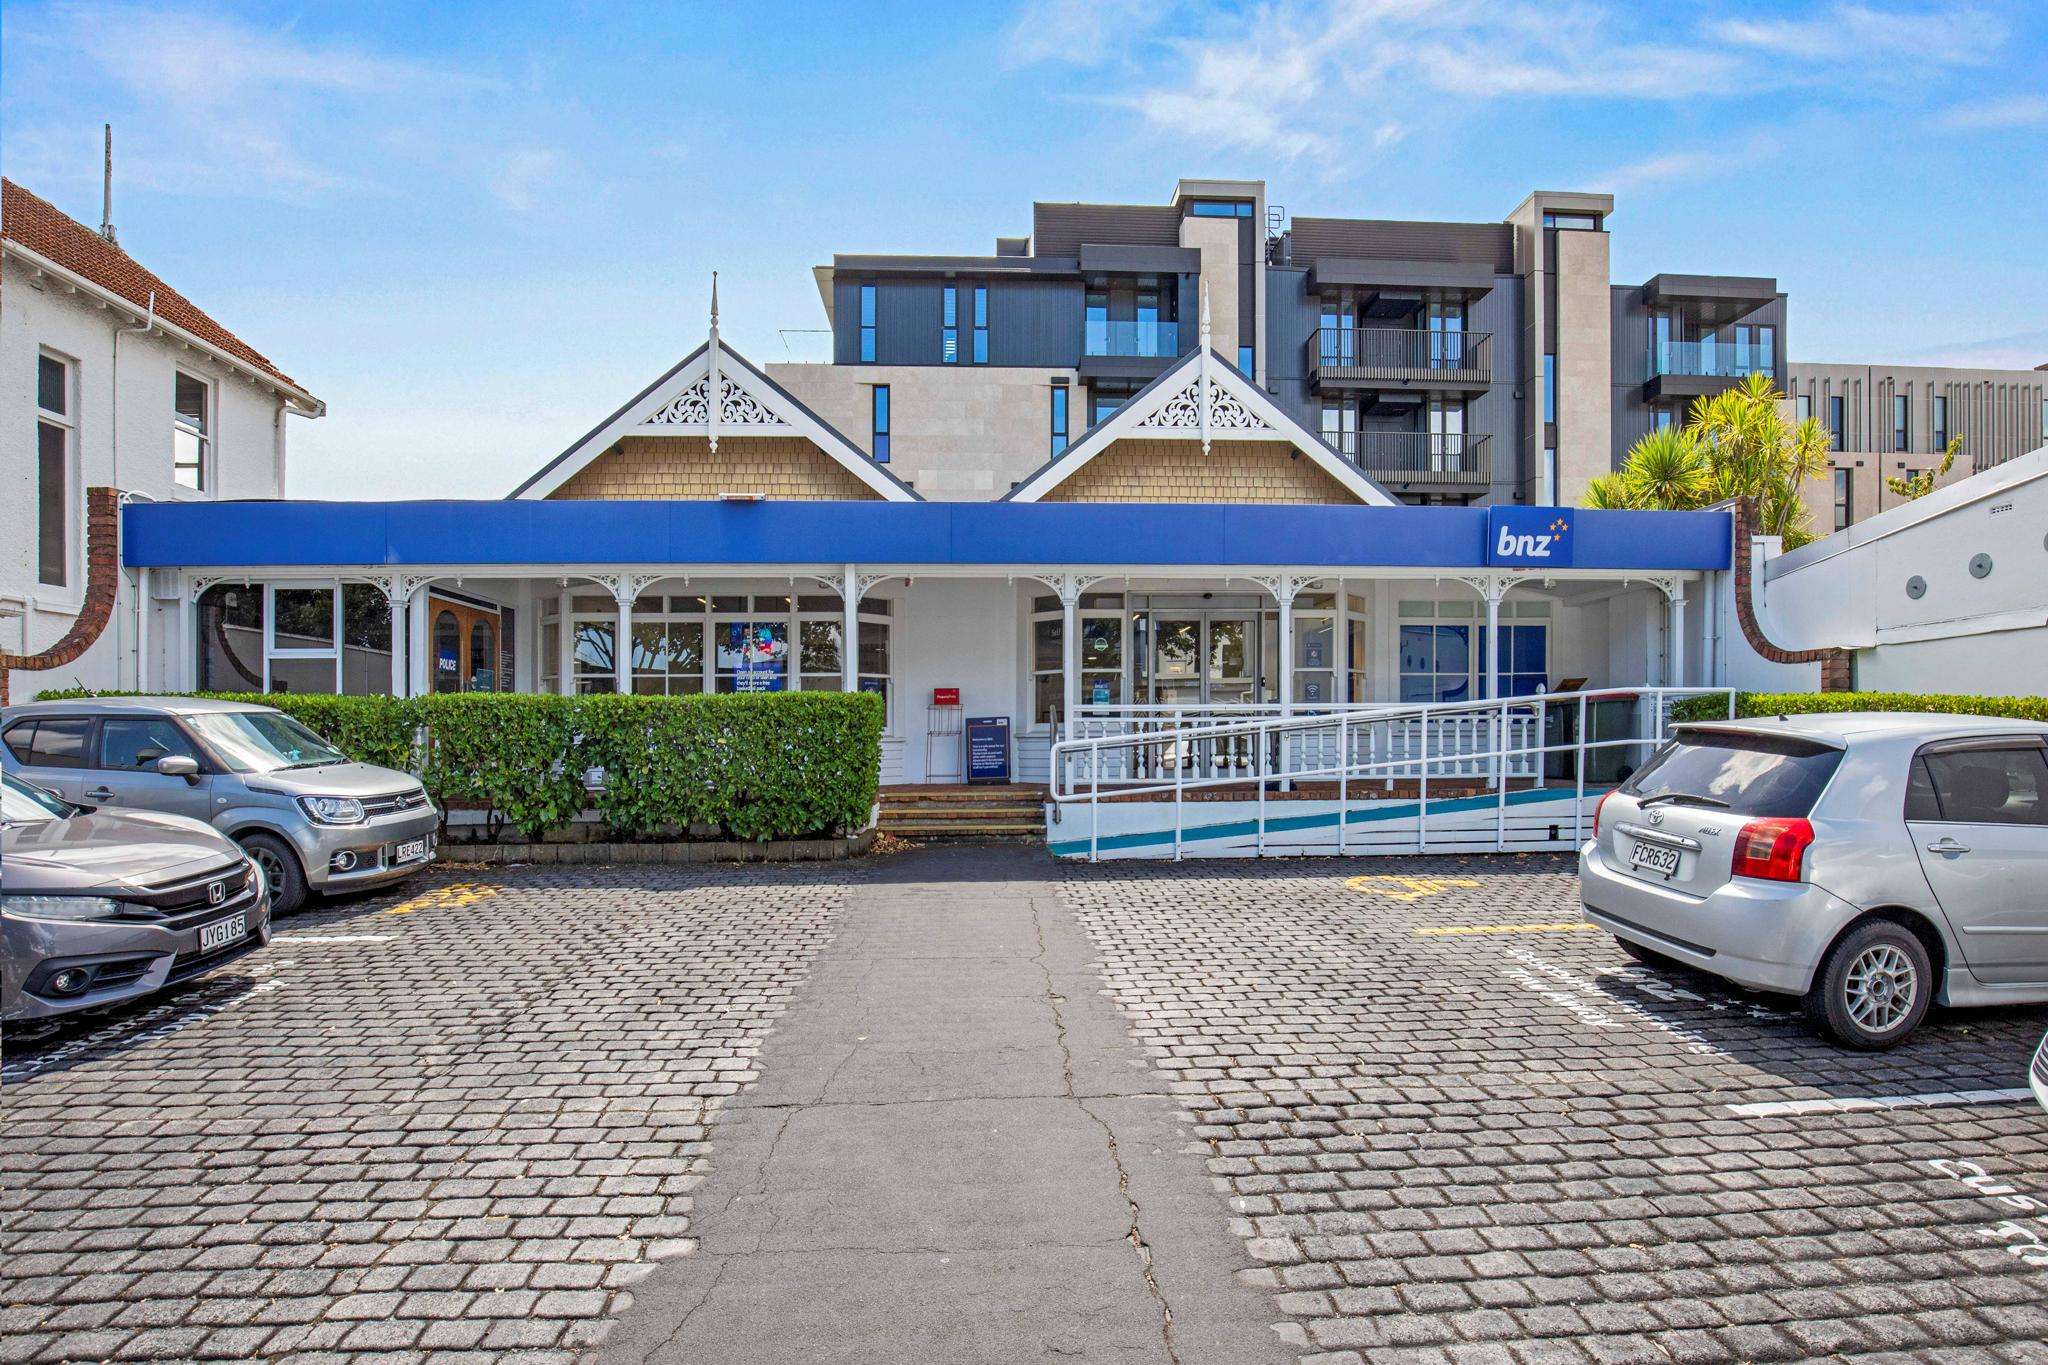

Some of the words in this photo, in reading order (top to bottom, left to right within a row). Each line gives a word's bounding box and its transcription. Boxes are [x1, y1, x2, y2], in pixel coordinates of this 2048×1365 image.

[1497, 525, 1552, 557] bnz
[439, 657, 456, 671] POLICE
[397, 842, 423, 859] LRE422
[1631, 844, 1677, 871] FCR632
[202, 918, 244, 947] JYG185
